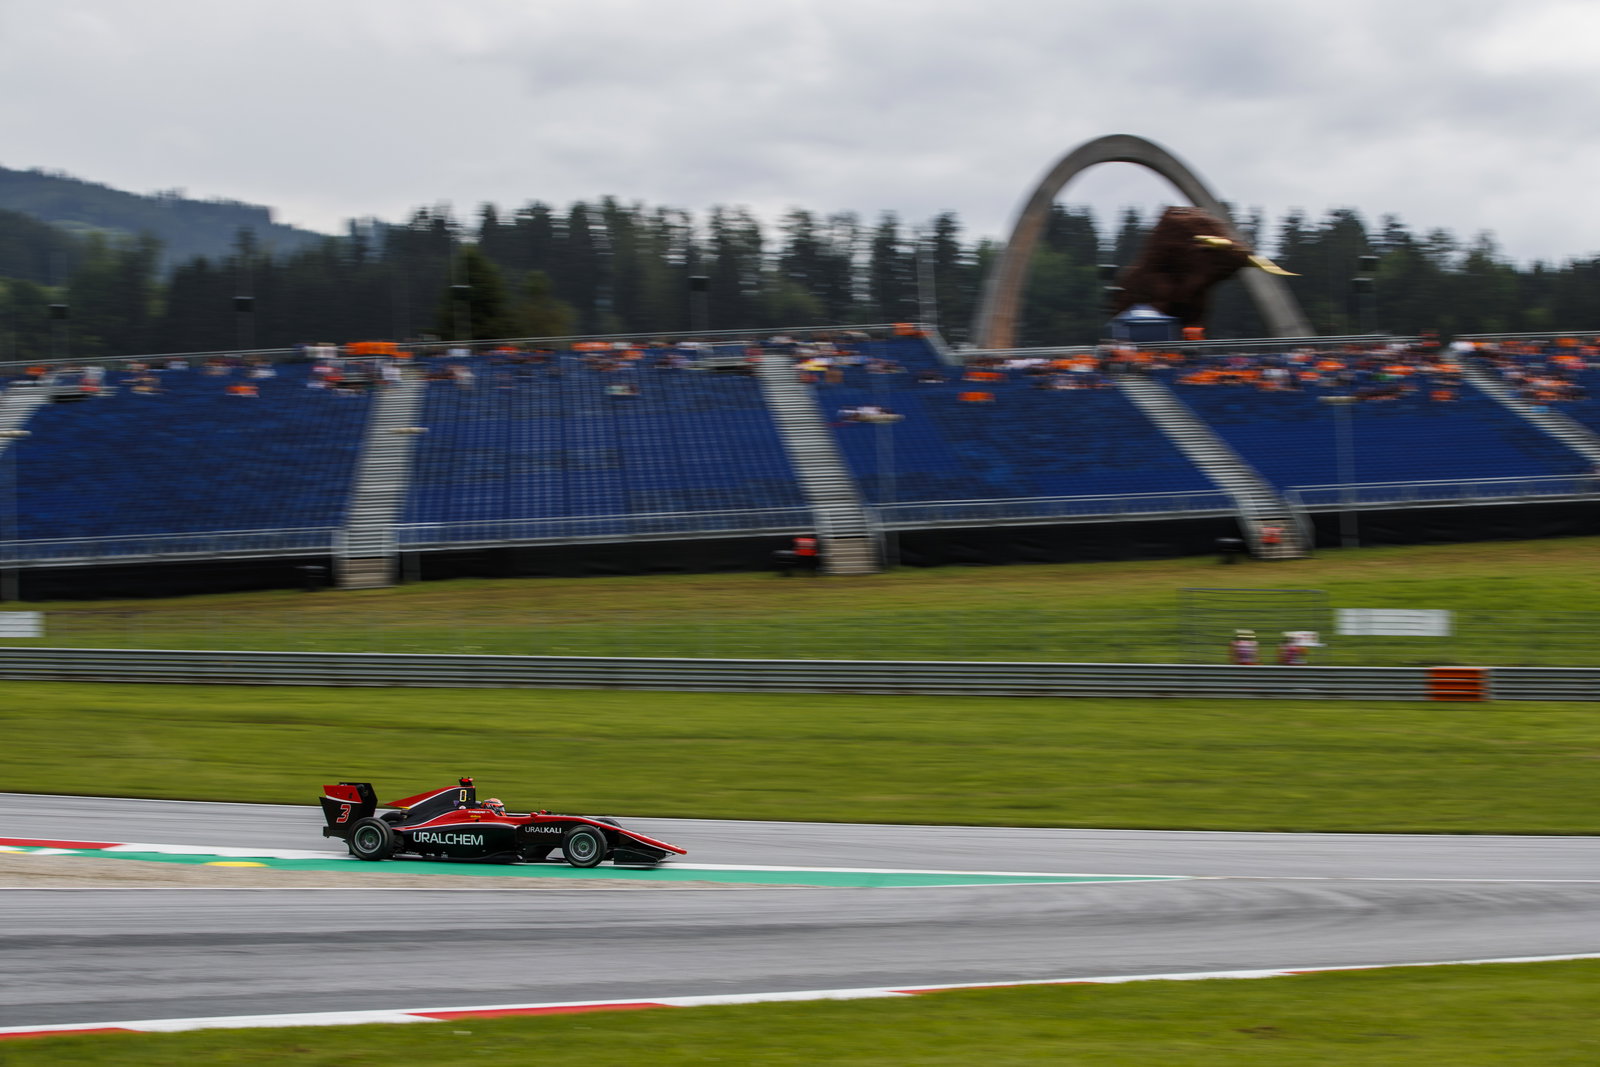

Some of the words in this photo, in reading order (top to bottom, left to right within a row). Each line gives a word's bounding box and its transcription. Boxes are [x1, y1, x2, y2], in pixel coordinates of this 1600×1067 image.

[336, 804, 352, 824] 3
[525, 826, 562, 834] URALKALI
[413, 831, 484, 846] URALCHEM
